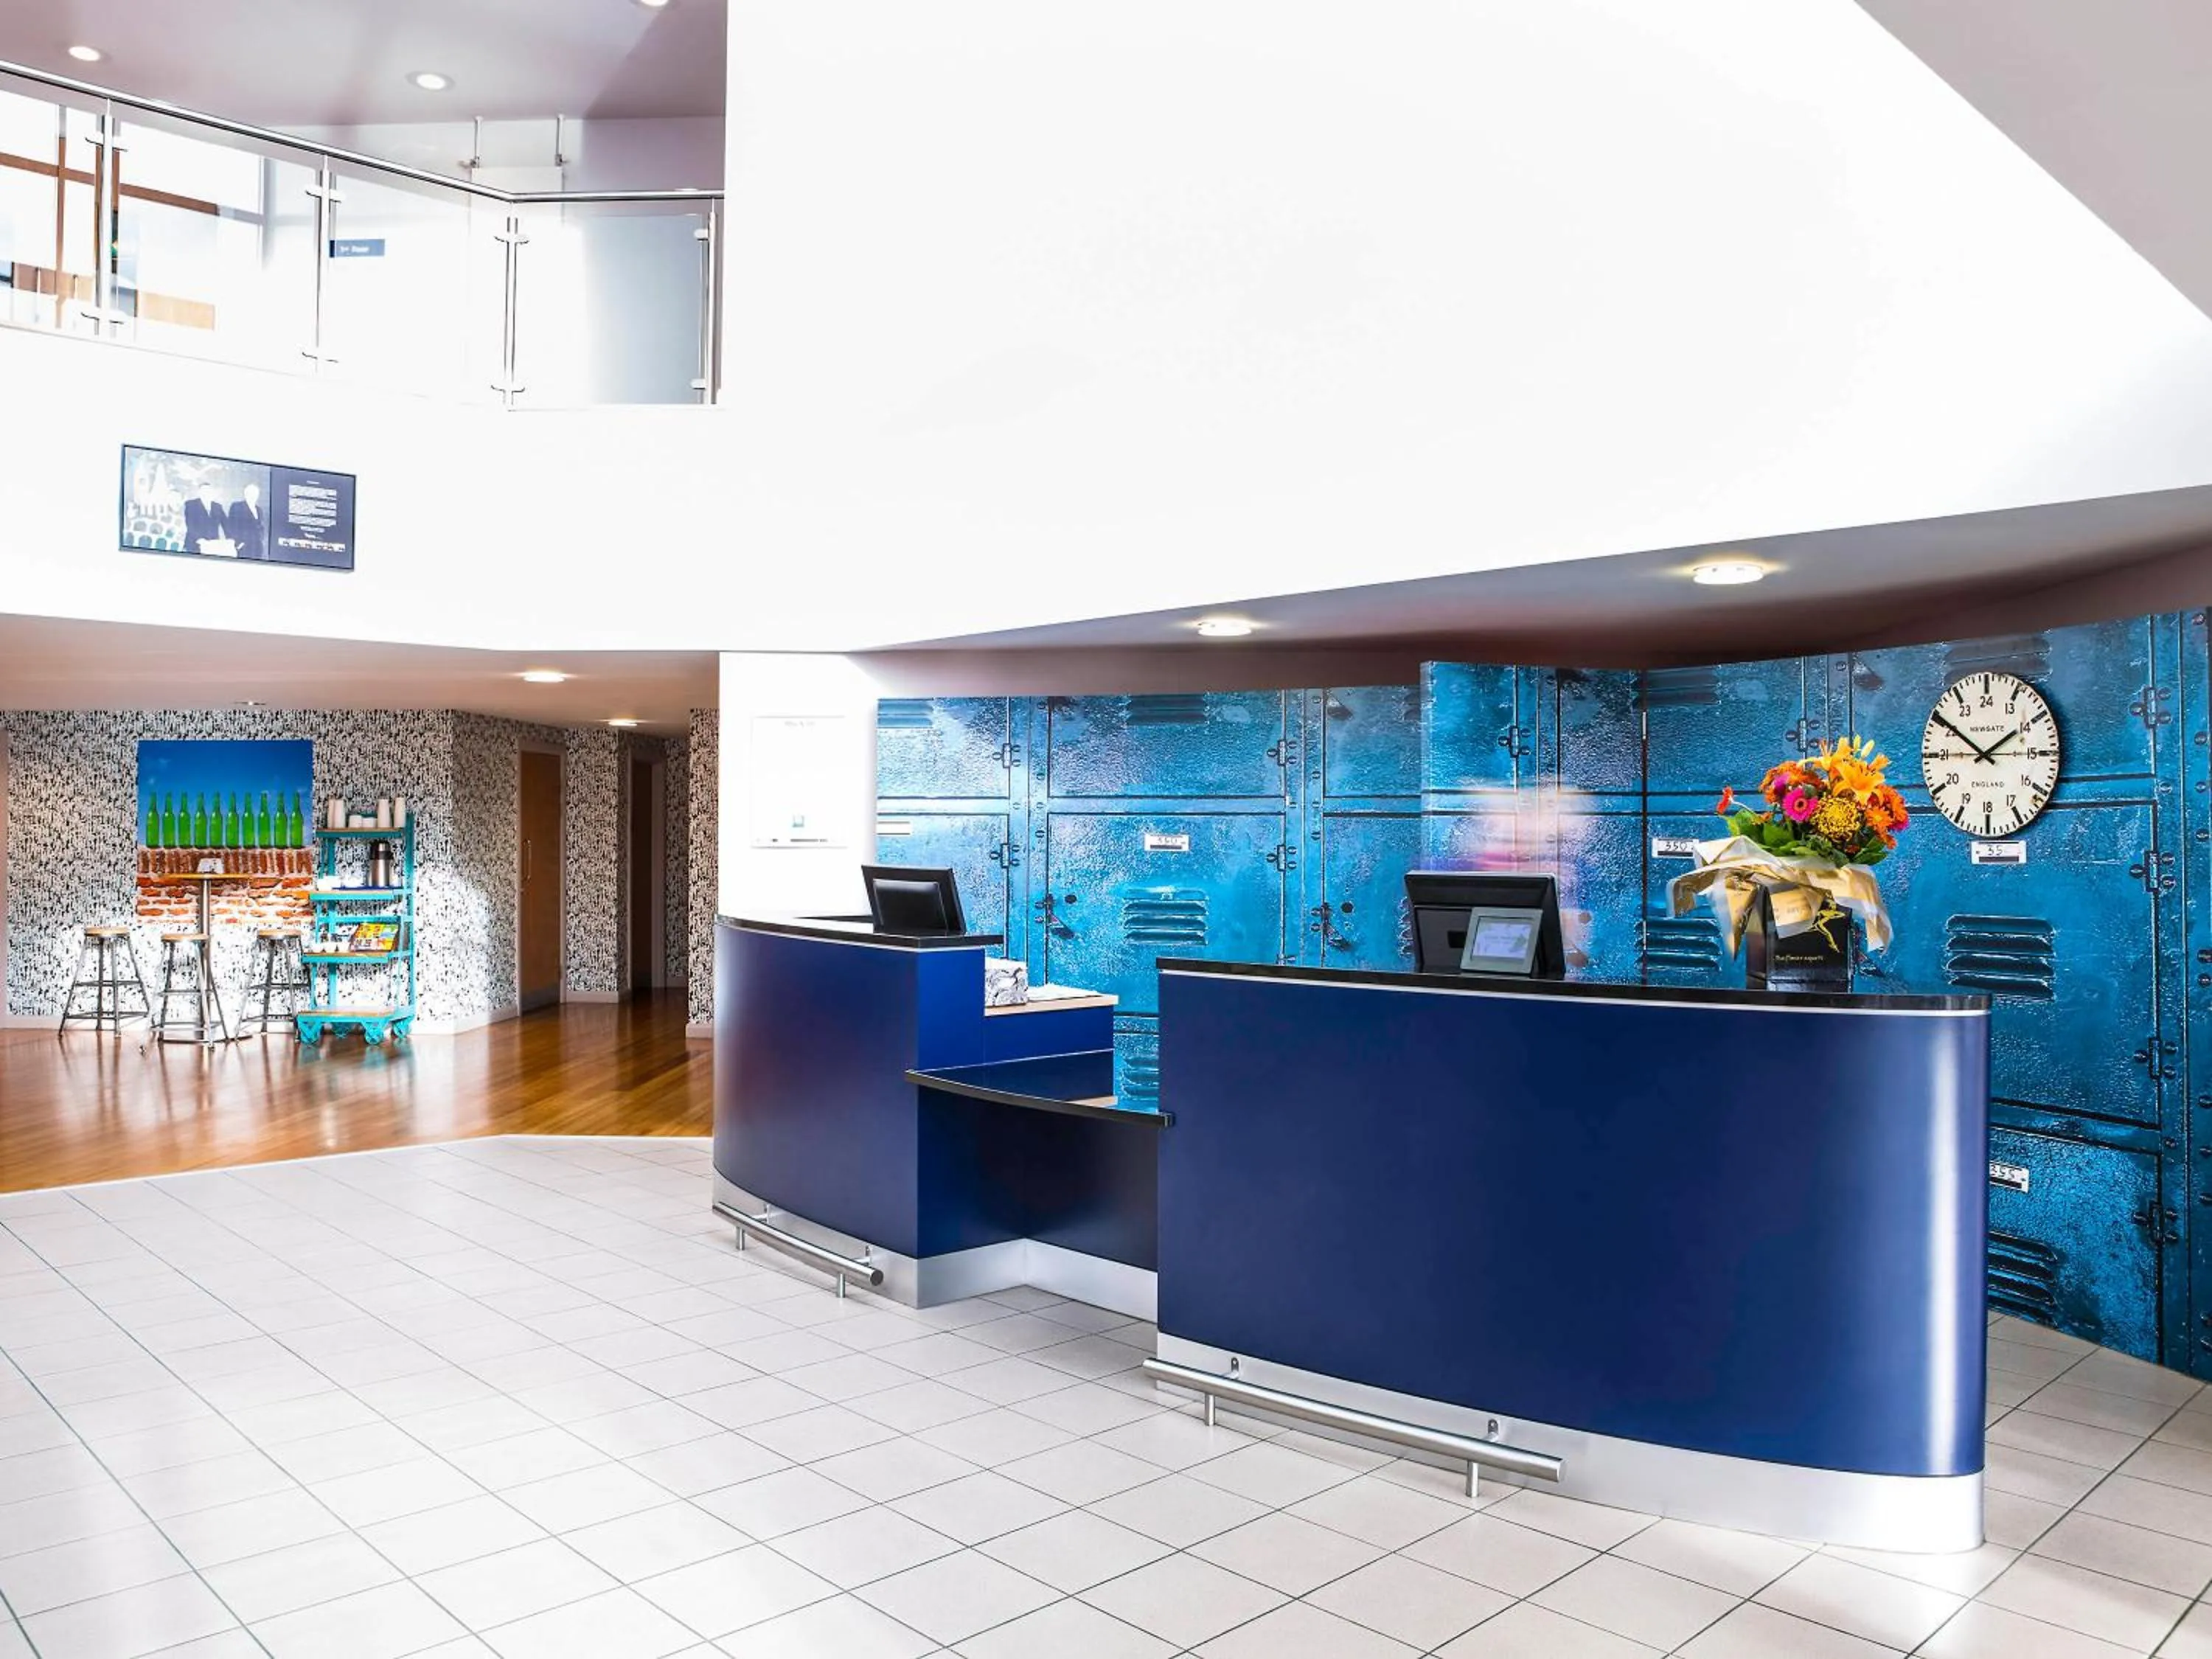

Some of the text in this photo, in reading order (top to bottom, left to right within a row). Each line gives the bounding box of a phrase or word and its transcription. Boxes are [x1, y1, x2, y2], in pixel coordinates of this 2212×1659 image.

[1980, 695, 1994, 708] 24
[1959, 705, 1971, 717] 23
[2005, 703, 2015, 714] 13
[2020, 722, 2031, 733] 14
[1940, 748, 1949, 760] 21
[2027, 747, 2037, 760] 15
[1946, 773, 1959, 785] 20
[2021, 774, 2031, 787] 16
[1961, 793, 1971, 804] 19
[2006, 794, 2017, 807] 17
[1983, 801, 1993, 813] 18
